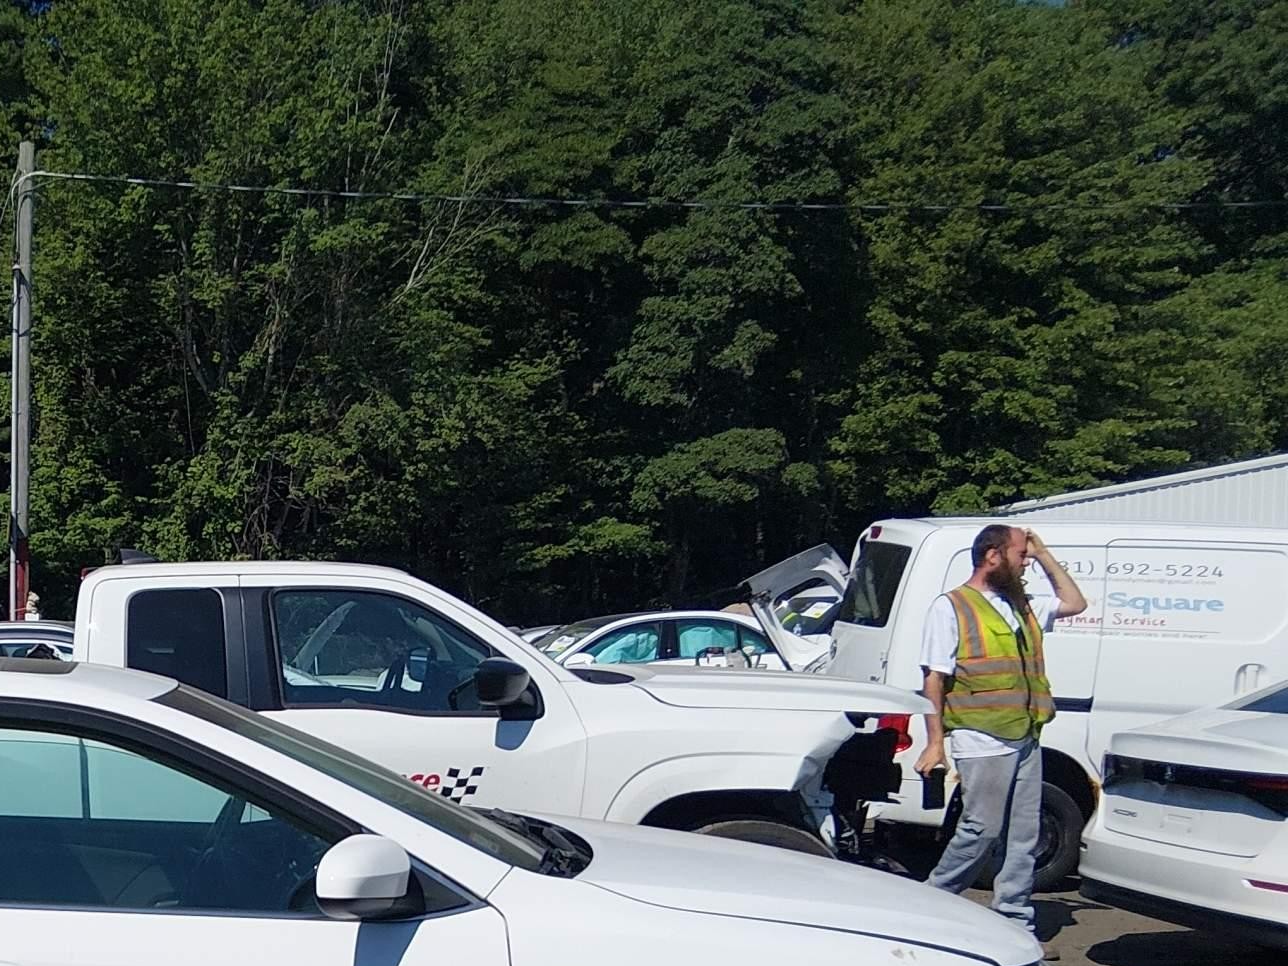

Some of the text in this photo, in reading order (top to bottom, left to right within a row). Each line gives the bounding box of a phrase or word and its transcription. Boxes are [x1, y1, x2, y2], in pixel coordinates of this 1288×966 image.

[1031, 560, 1225, 578] (81) 692-5224
[1107, 592, 1225, 615] Square
[1112, 613, 1167, 627] Service
